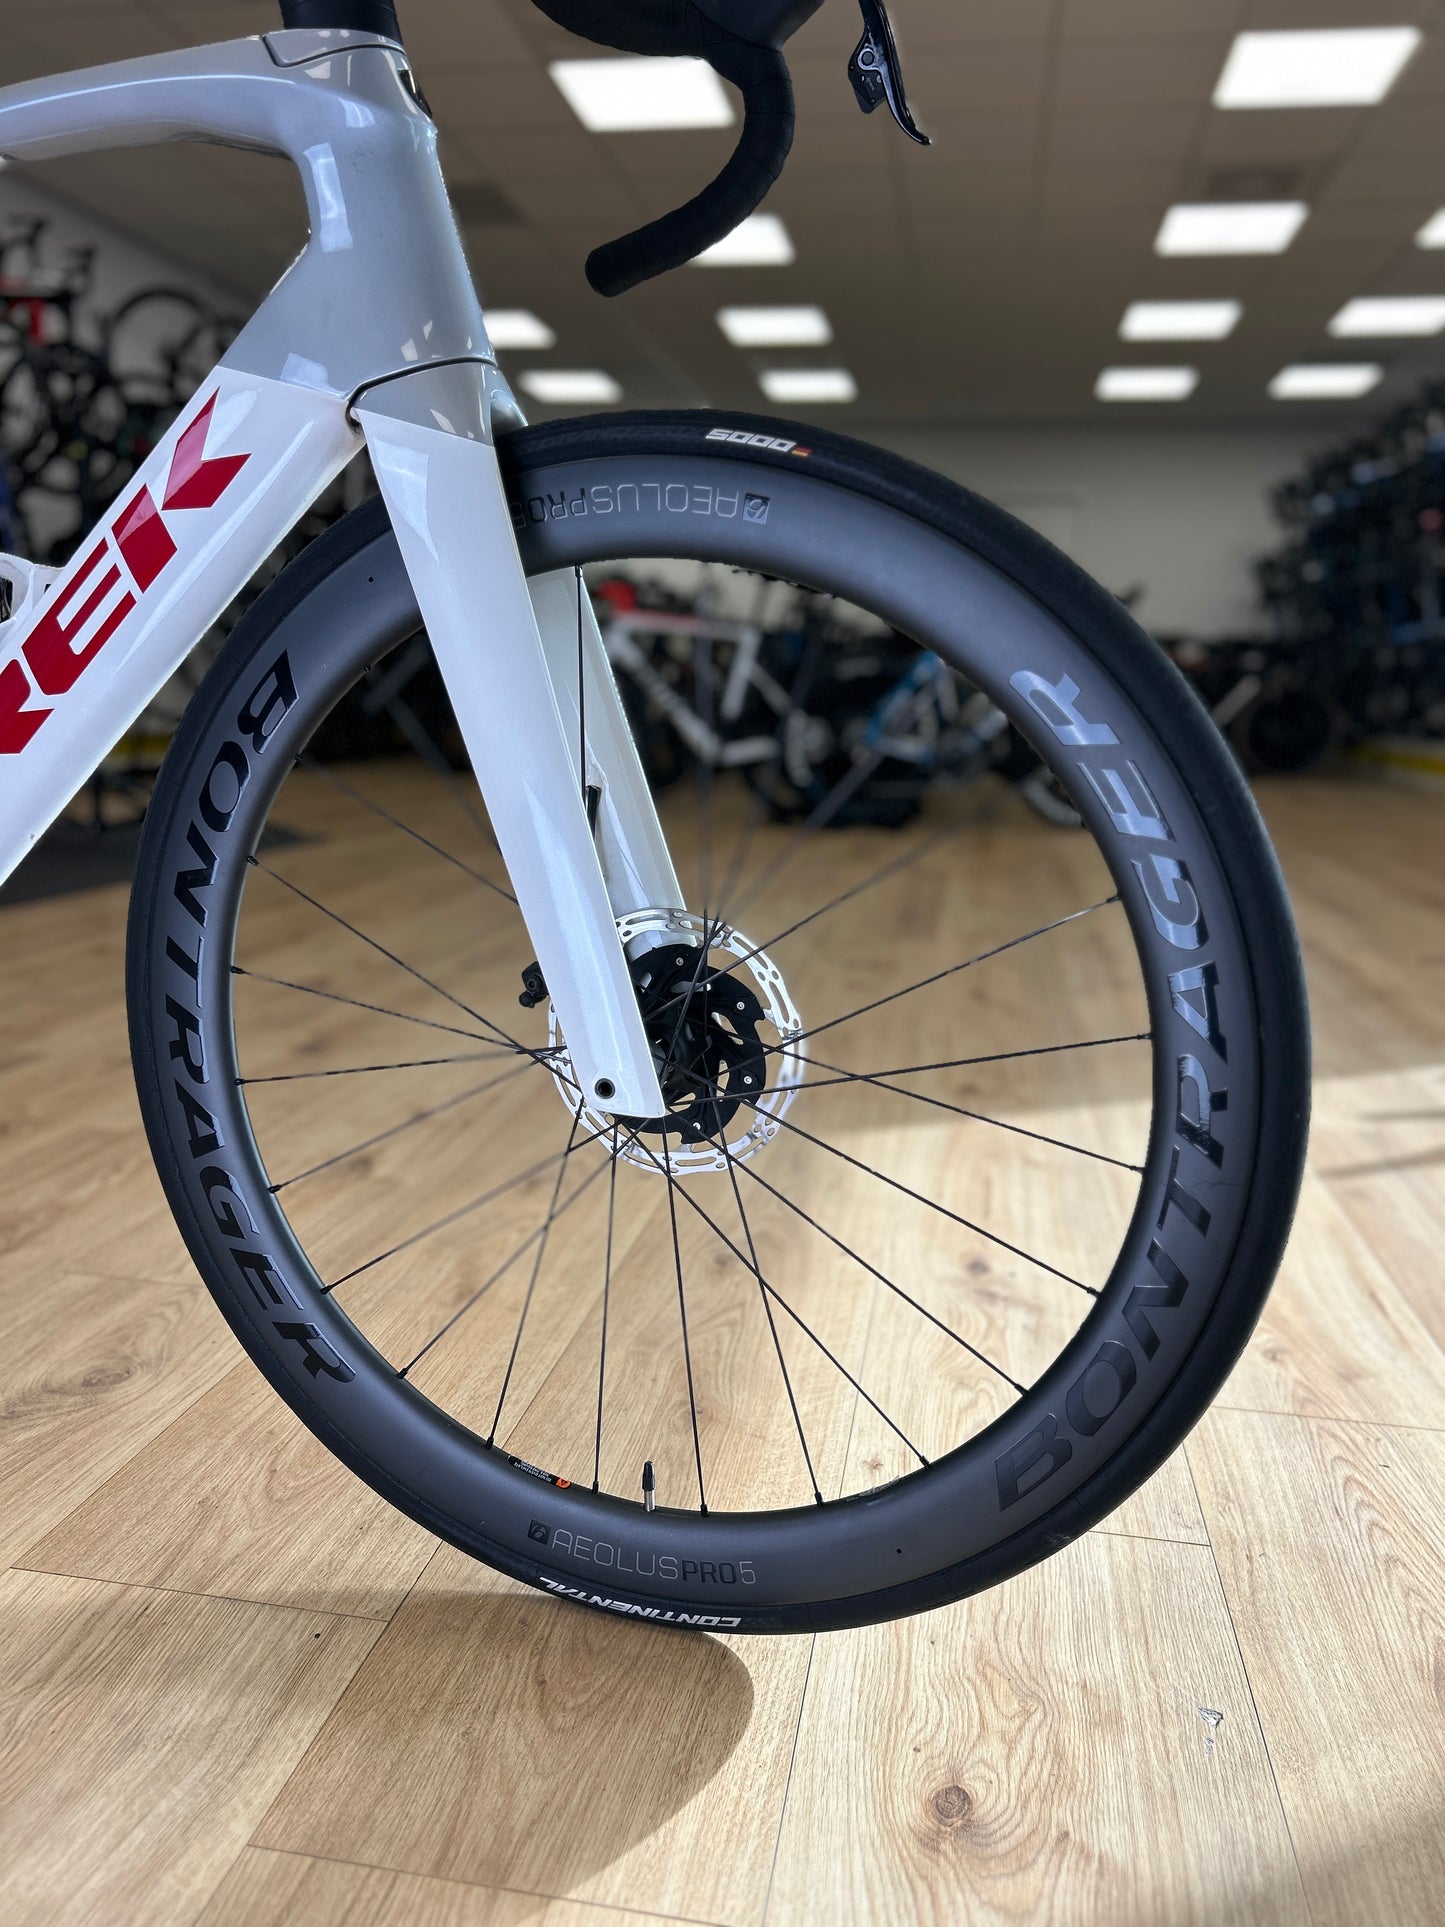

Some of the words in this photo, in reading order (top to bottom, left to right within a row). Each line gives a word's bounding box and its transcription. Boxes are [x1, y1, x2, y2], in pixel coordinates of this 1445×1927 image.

[705, 428, 798, 453] 5000
[165, 648, 356, 1383] BONTRAGER
[994, 670, 1230, 1512] BONTRAGER
[540, 1576, 742, 1628] CONTINENTAL
